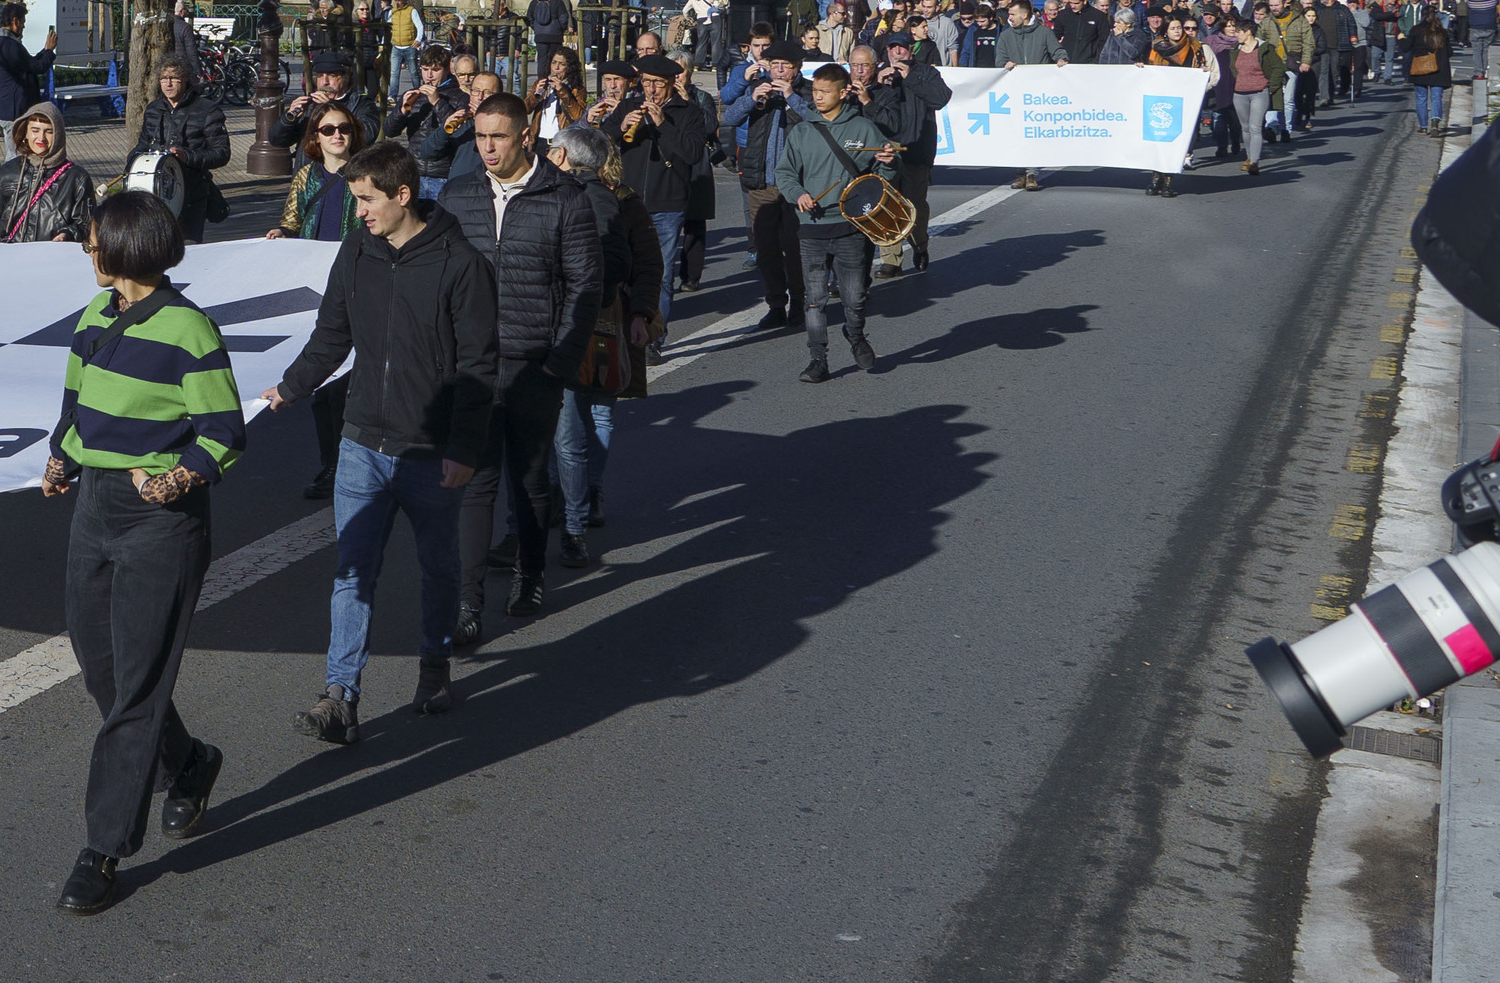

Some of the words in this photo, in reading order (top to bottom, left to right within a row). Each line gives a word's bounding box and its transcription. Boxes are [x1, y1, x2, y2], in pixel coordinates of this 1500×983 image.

[1023, 92, 1072, 106] Bakea.
[1023, 109, 1128, 124] Konponbidea.
[1024, 125, 1112, 139] Elkarbizitza.
